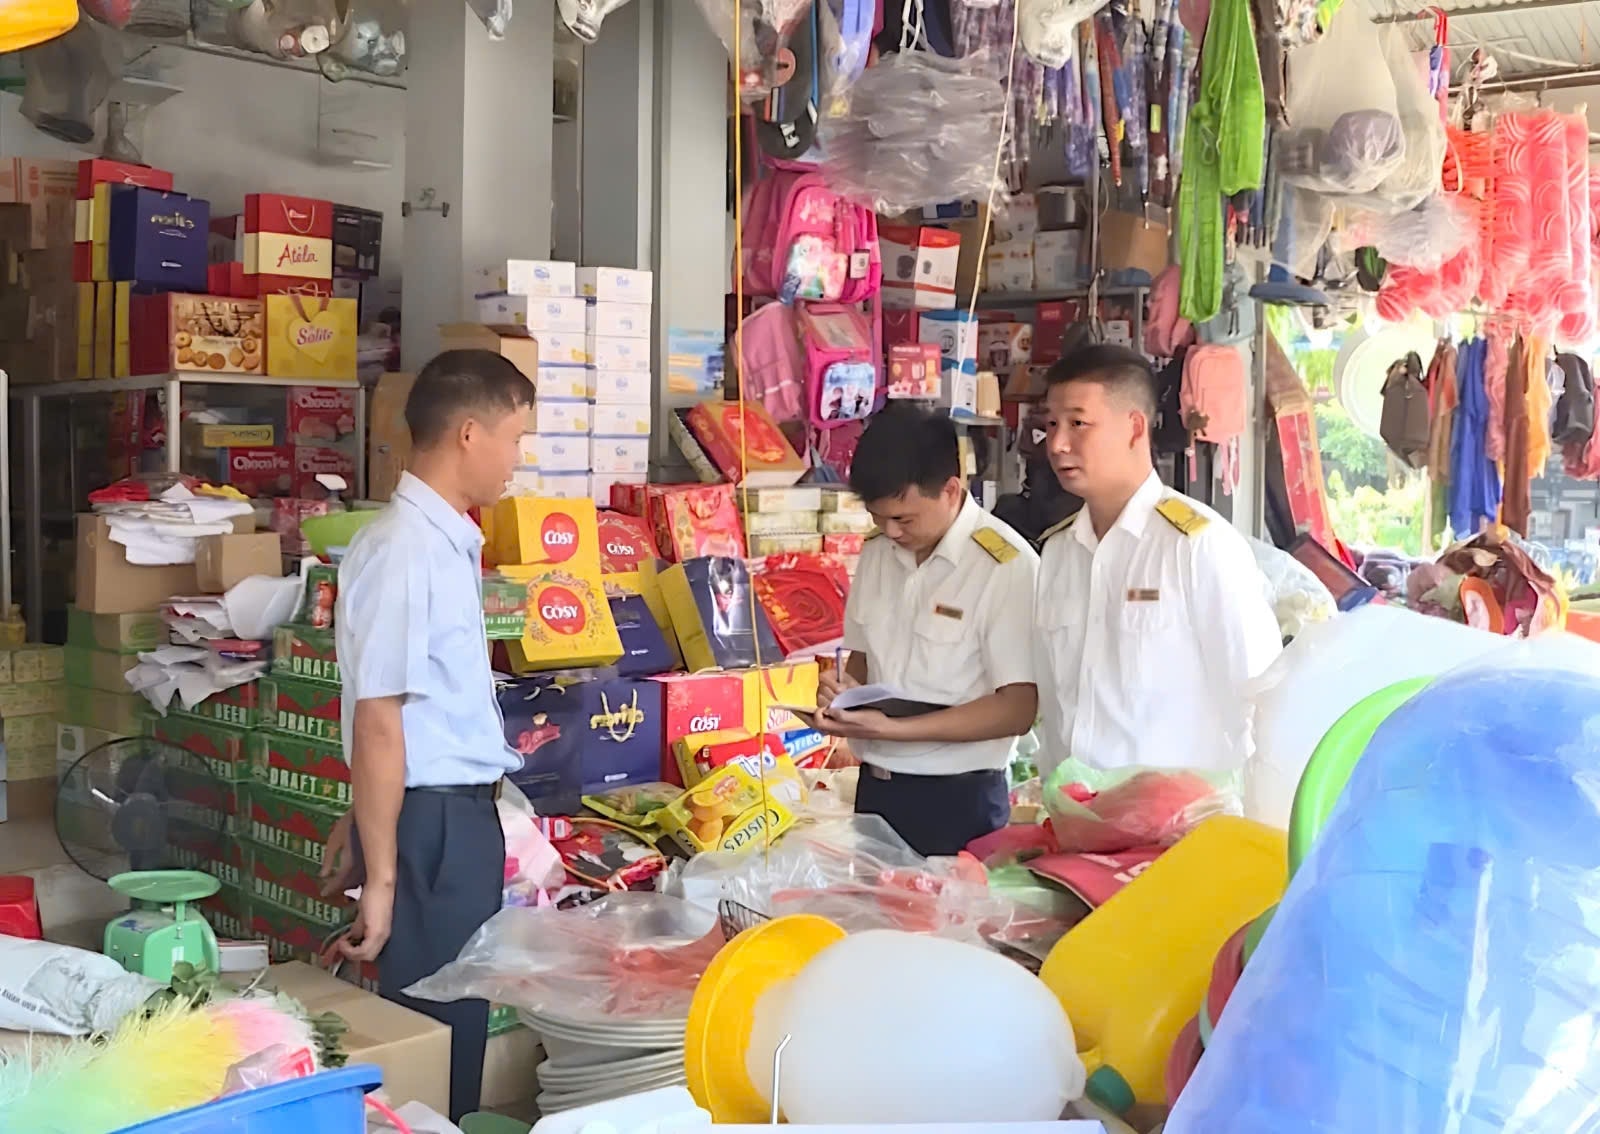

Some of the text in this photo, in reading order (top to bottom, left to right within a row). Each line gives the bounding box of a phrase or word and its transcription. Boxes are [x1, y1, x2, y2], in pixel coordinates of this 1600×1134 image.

[293, 656, 338, 681] DRAFT
[215, 703, 247, 725] BEER
[278, 711, 324, 736] DRAFT
[270, 767, 318, 794] DRAFT
[253, 821, 289, 847] DRAFT
[255, 878, 341, 924] DRAFT BEER
